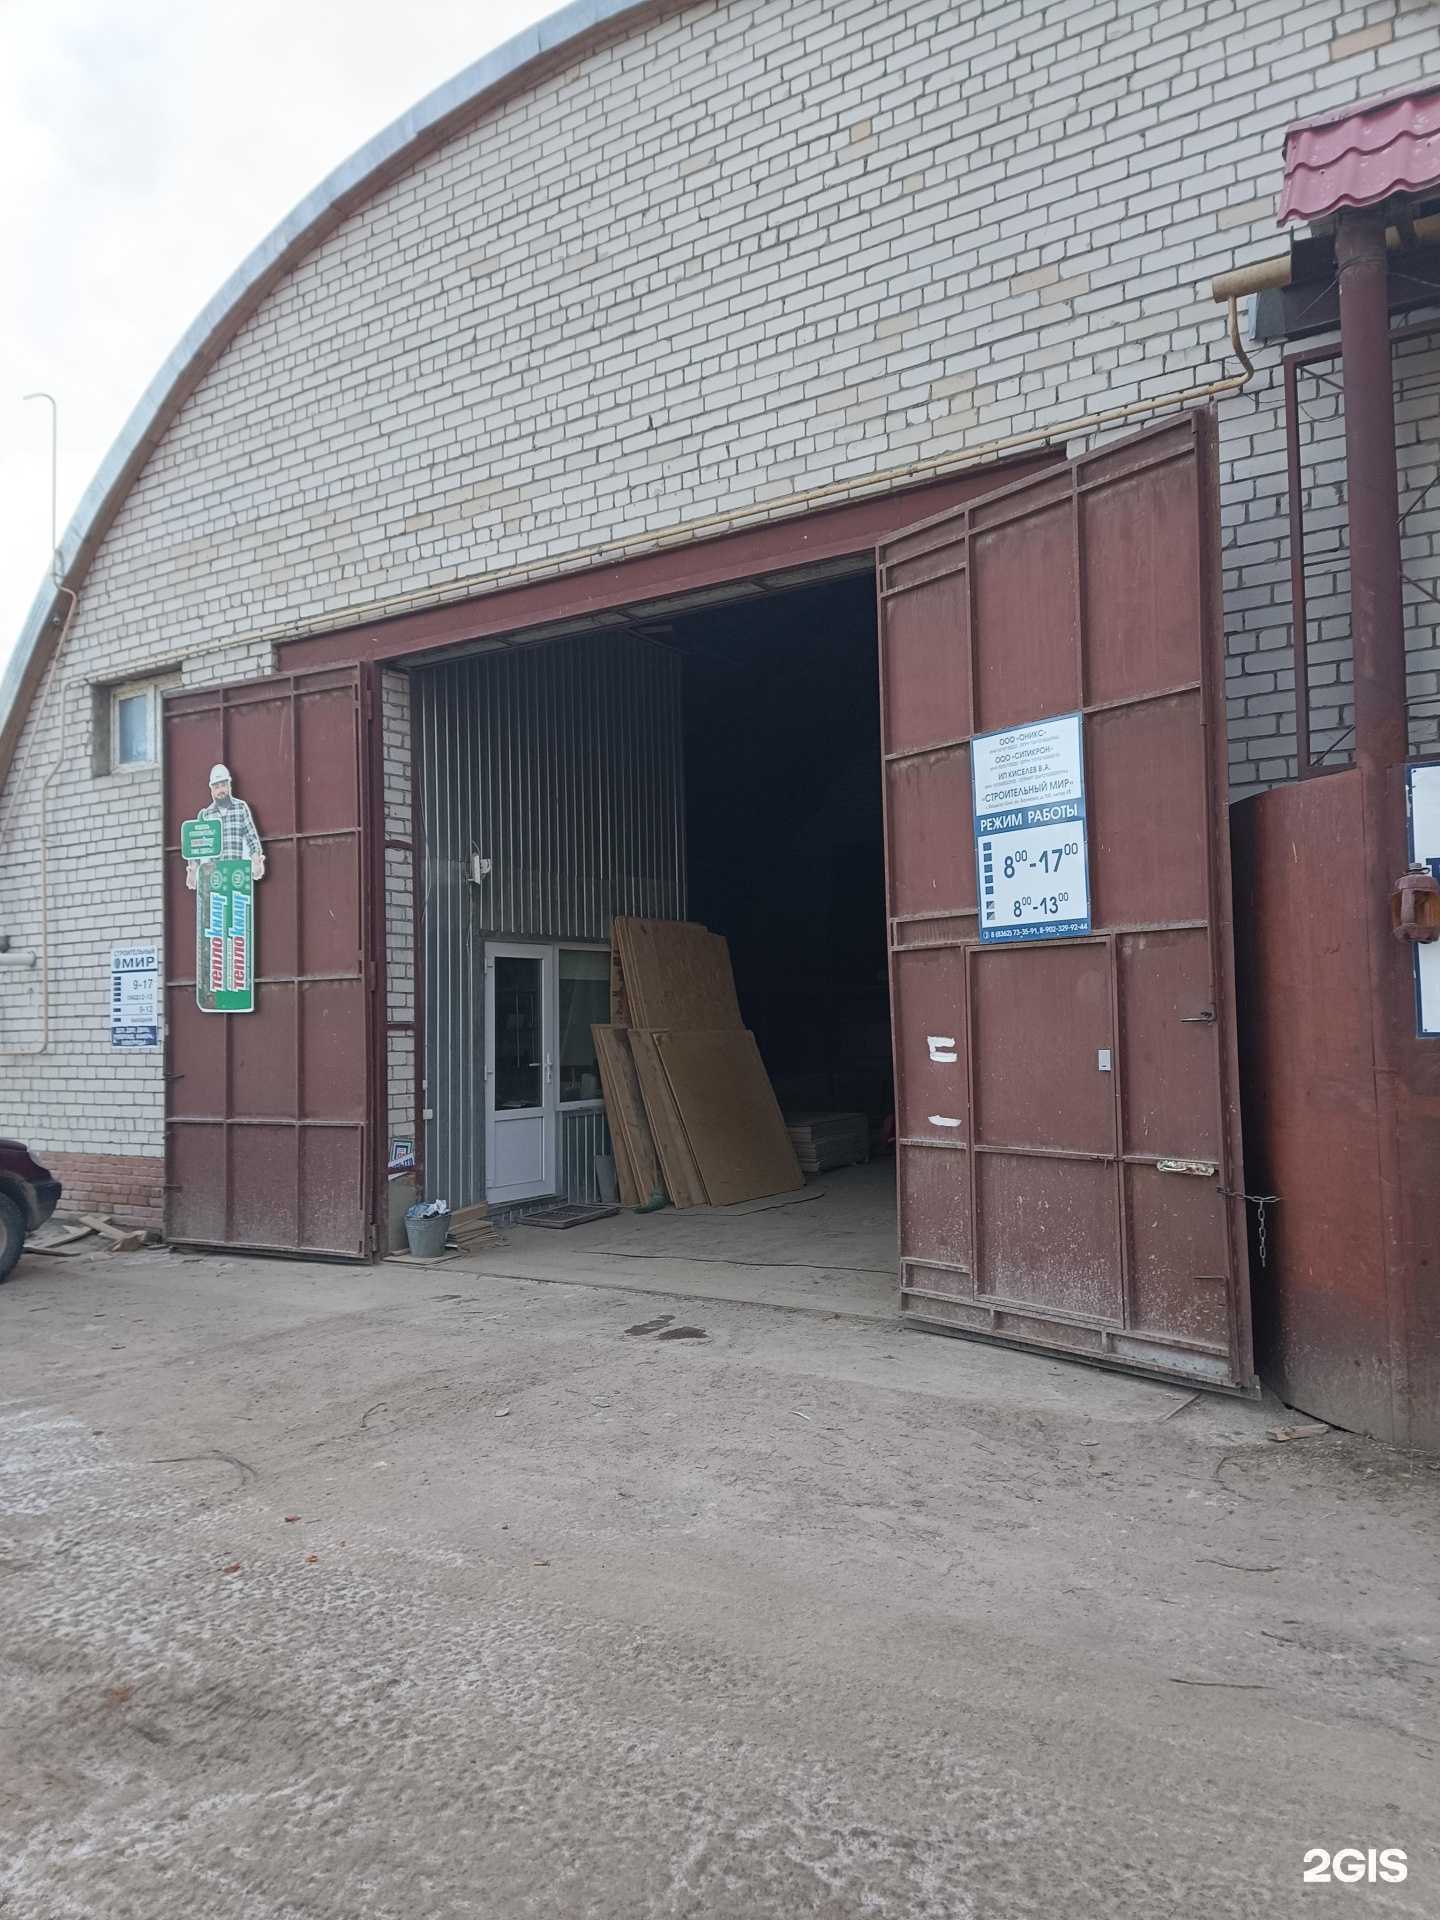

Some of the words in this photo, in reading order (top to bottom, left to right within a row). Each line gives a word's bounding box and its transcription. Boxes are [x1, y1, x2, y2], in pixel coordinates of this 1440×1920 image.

[999, 735, 1015, 746] ООО
[980, 813, 1023, 832] РЕЖИМ
[1027, 804, 1078, 824] РАБОТЫ
[122, 956, 155, 969] МИР
